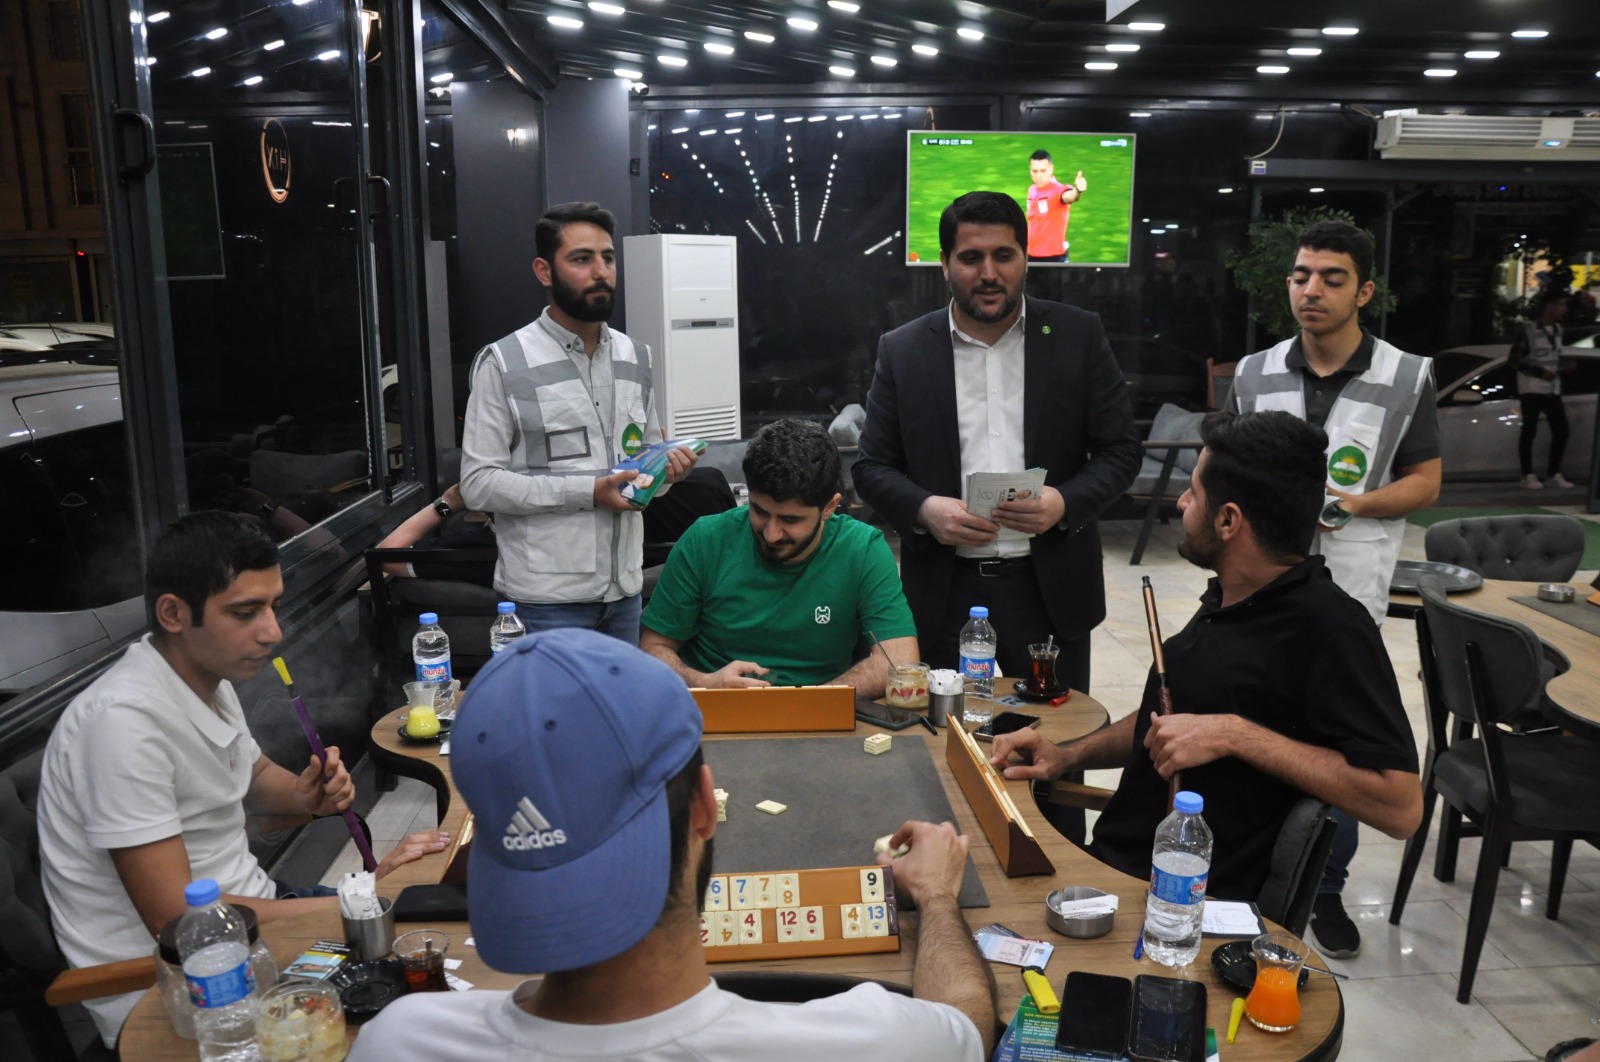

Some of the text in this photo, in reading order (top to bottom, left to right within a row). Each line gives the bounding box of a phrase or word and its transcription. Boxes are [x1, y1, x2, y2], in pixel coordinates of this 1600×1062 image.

[502, 828, 567, 851] adidas
[711, 872, 877, 904] 6 7 7 8 9
[722, 928, 733, 942] 4
[744, 912, 755, 927] 4
[780, 911, 797, 926] 12
[806, 910, 817, 924] 6
[847, 907, 859, 921] 4
[867, 905, 884, 920] 13
